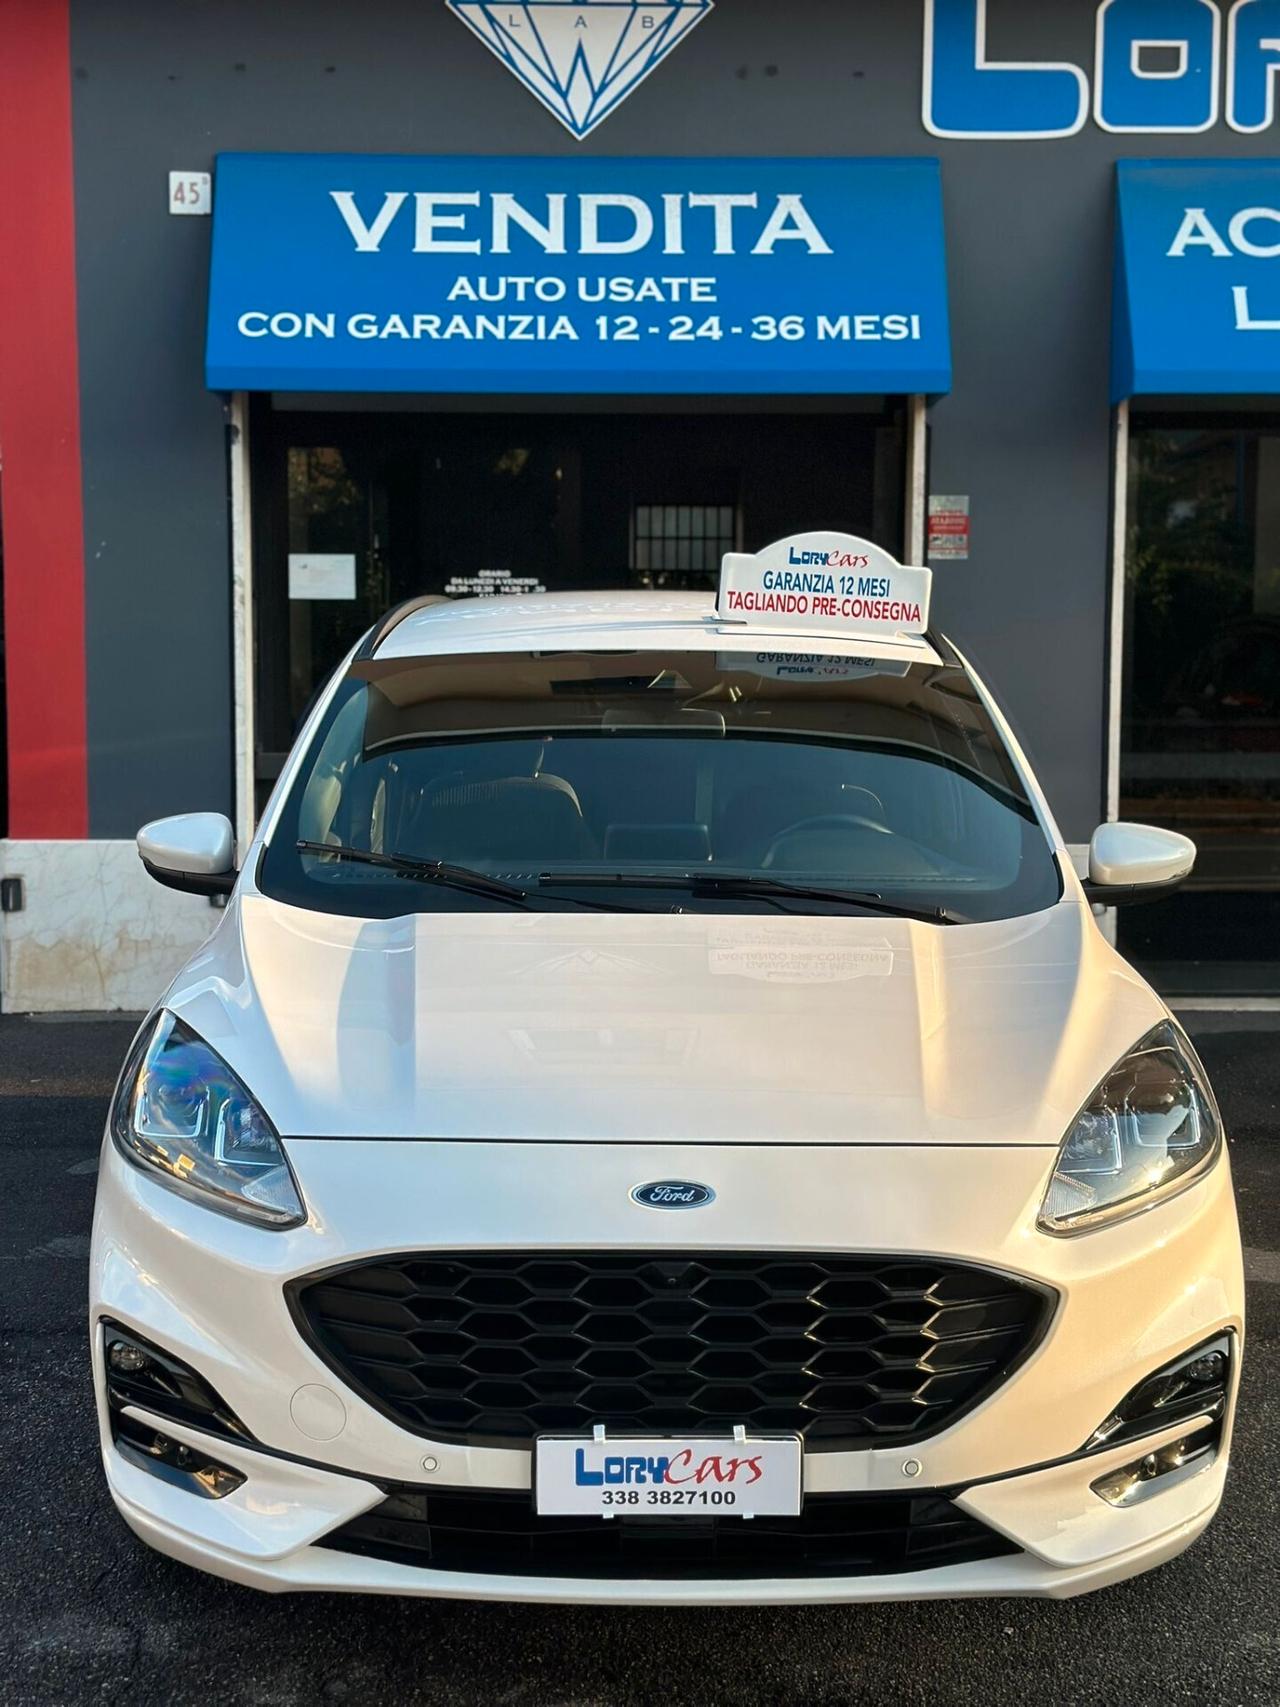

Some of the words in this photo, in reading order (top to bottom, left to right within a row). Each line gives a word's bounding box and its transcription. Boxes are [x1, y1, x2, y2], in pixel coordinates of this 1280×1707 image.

[330, 192, 833, 255] VENDITA
[448, 277, 565, 302] AUTO
[579, 277, 717, 302] USATE
[238, 312, 335, 338] CON
[348, 314, 578, 340] GARANZIA
[818, 315, 920, 340] MESI
[763, 571, 834, 594] GARANZIA
[840, 577, 854, 595] 12
[858, 577, 891, 597] MESI
[728, 591, 808, 614] TAGLIANDO
[812, 597, 921, 622] PRE-CONSEGNA
[650, 1185, 695, 1202] Ford
[602, 1491, 640, 1505] 338
[647, 1491, 736, 1505] 3827100
